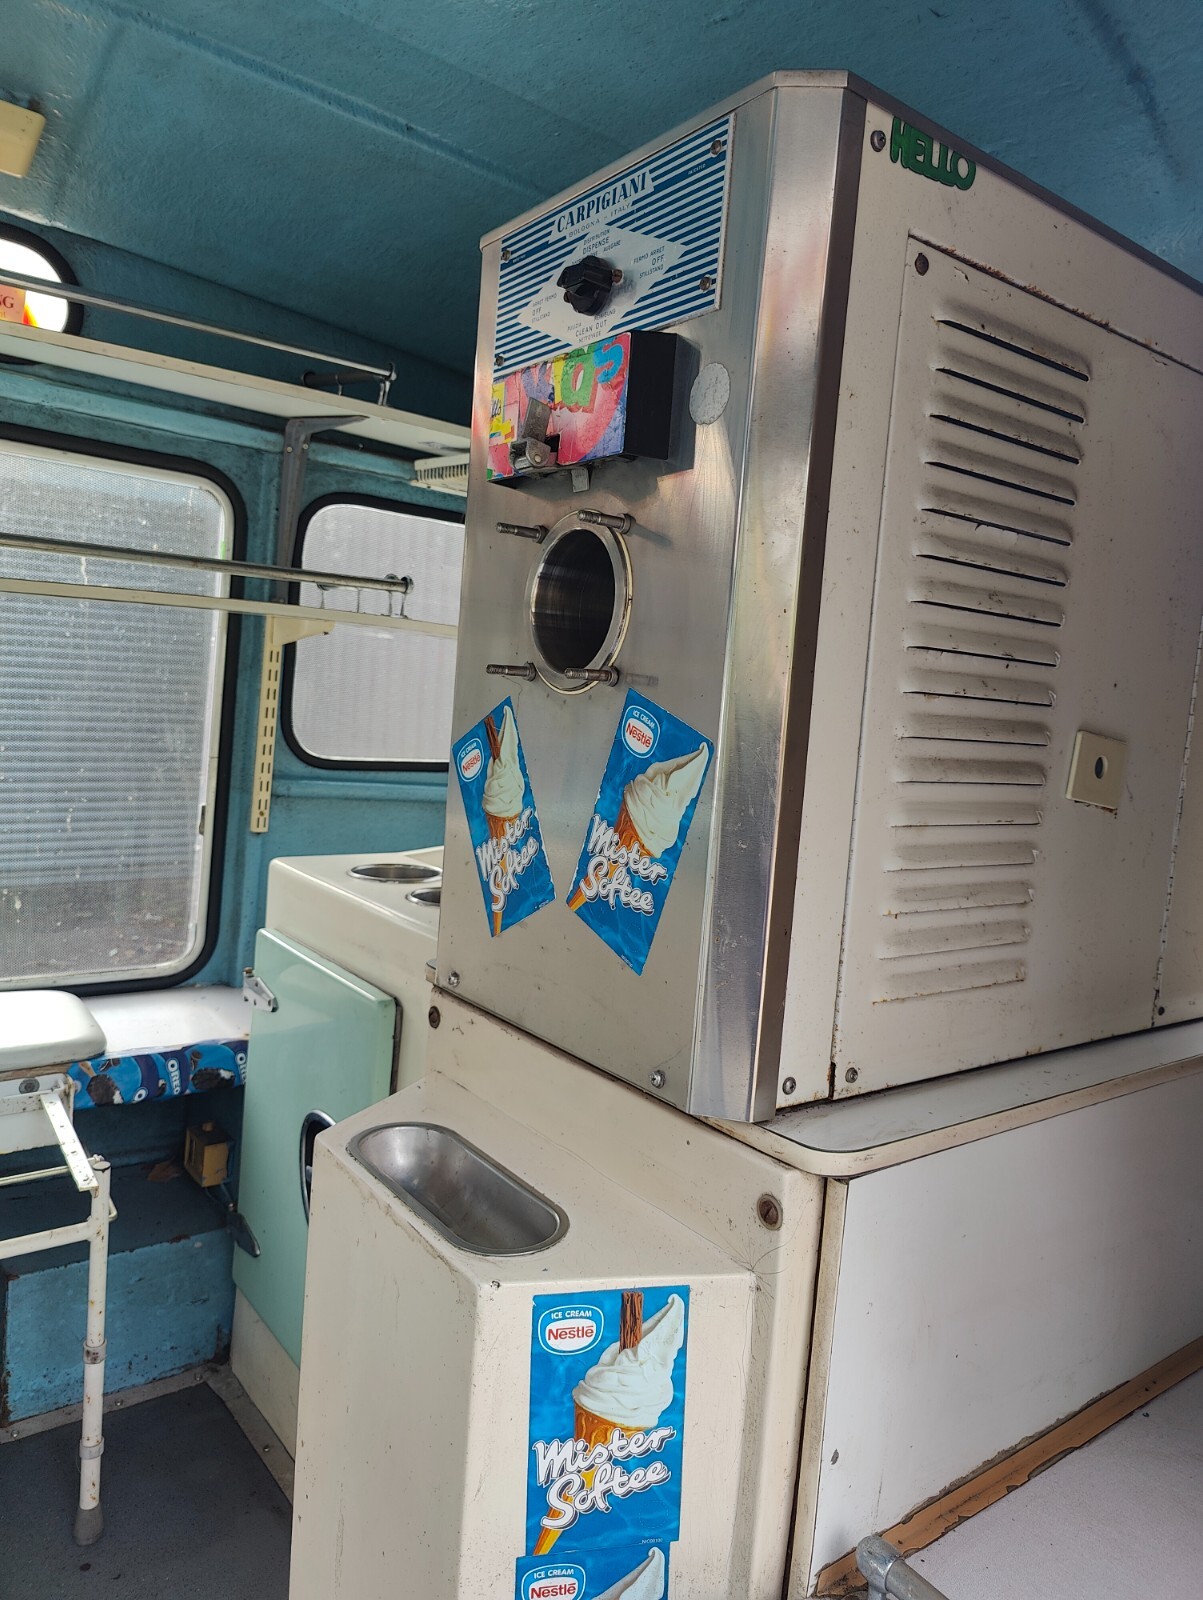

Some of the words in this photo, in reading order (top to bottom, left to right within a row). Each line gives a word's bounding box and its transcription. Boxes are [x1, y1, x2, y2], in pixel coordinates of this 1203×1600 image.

[889, 115, 977, 191] HELLO
[556, 171, 647, 234] CARPIGIANI
[568, 218, 600, 238] BOLOGNA
[610, 203, 630, 217] ITALY
[582, 236, 610, 255] DISPENSE
[651, 254, 665, 266] OFF
[575, 325, 593, 337] CLEAN
[595, 319, 607, 330] OUT
[632, 710, 640, 718] ICE
[640, 713, 655, 729] CREAM
[475, 806, 533, 881] Mister
[587, 814, 668, 885] Mister
[489, 836, 539, 912] Softee
[579, 854, 655, 916] Softee
[167, 1059, 181, 1095] OREO
[565, 1310, 592, 1318] CREAM
[532, 1426, 676, 1487] Mister
[541, 1460, 671, 1530] Softee
[533, 1571, 545, 1579] ICE
[547, 1568, 575, 1577] CREAM
